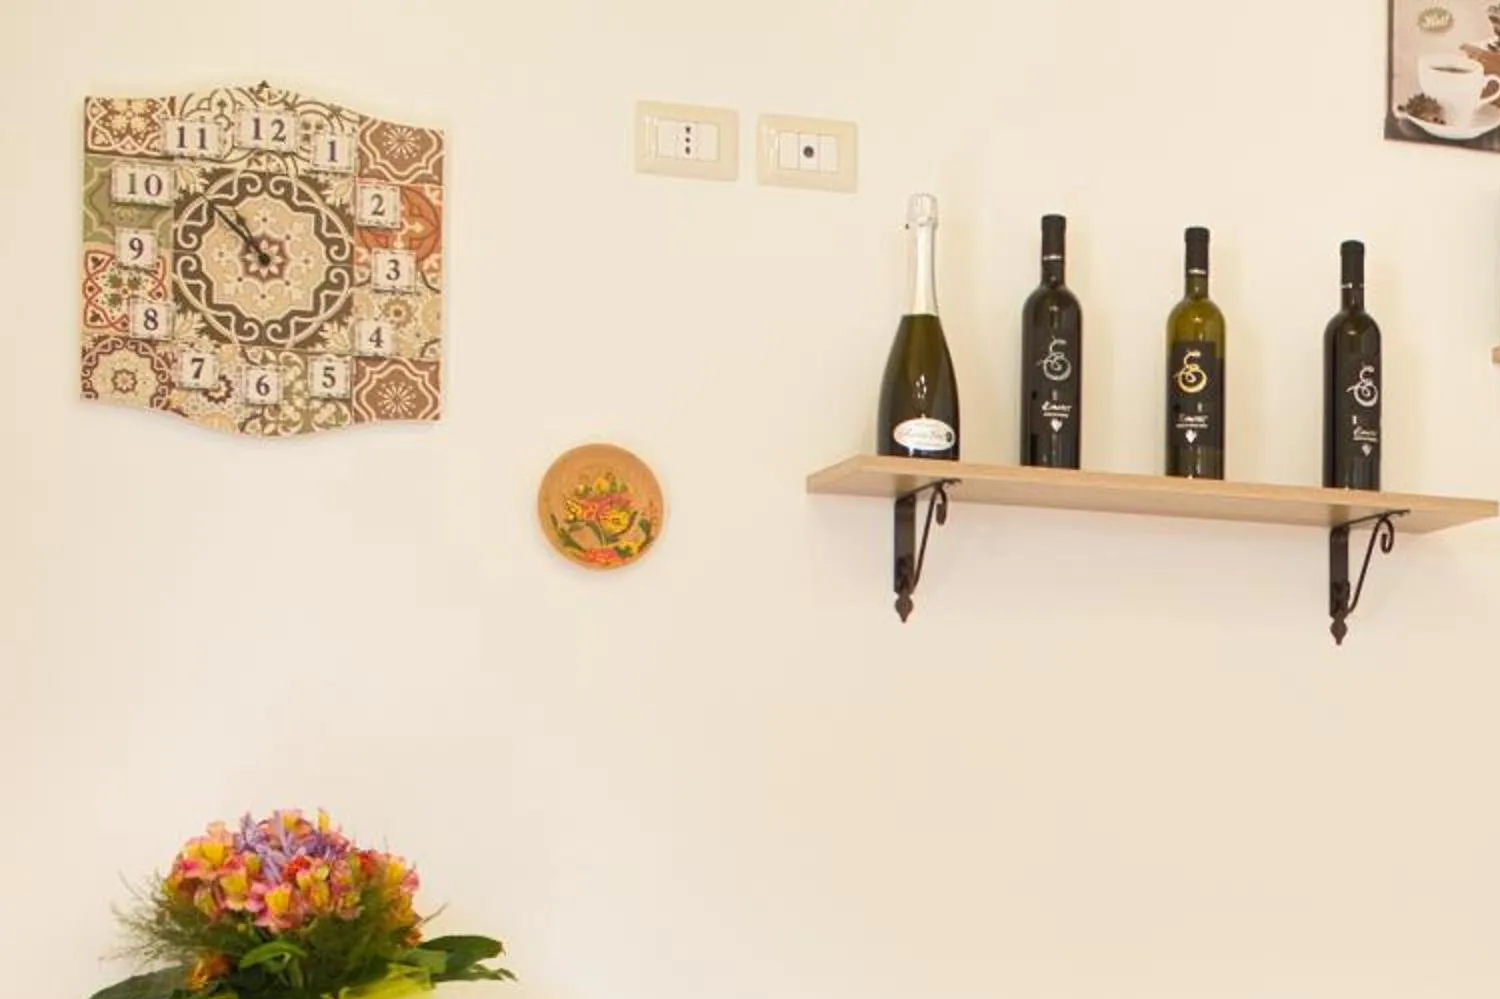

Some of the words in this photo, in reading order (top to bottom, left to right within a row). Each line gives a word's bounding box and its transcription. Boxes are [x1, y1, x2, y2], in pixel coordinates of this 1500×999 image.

[175, 125, 208, 151] 11
[250, 118, 287, 142] 12
[326, 140, 337, 162] 1
[125, 173, 163, 196] 10
[370, 193, 385, 215] 2
[129, 237, 144, 259] 9
[385, 259, 401, 280] 3
[143, 308, 158, 330] 8
[367, 326, 383, 348] 4
[190, 357, 206, 379] 7
[322, 365, 336, 388] 5
[255, 374, 270, 395] 6
